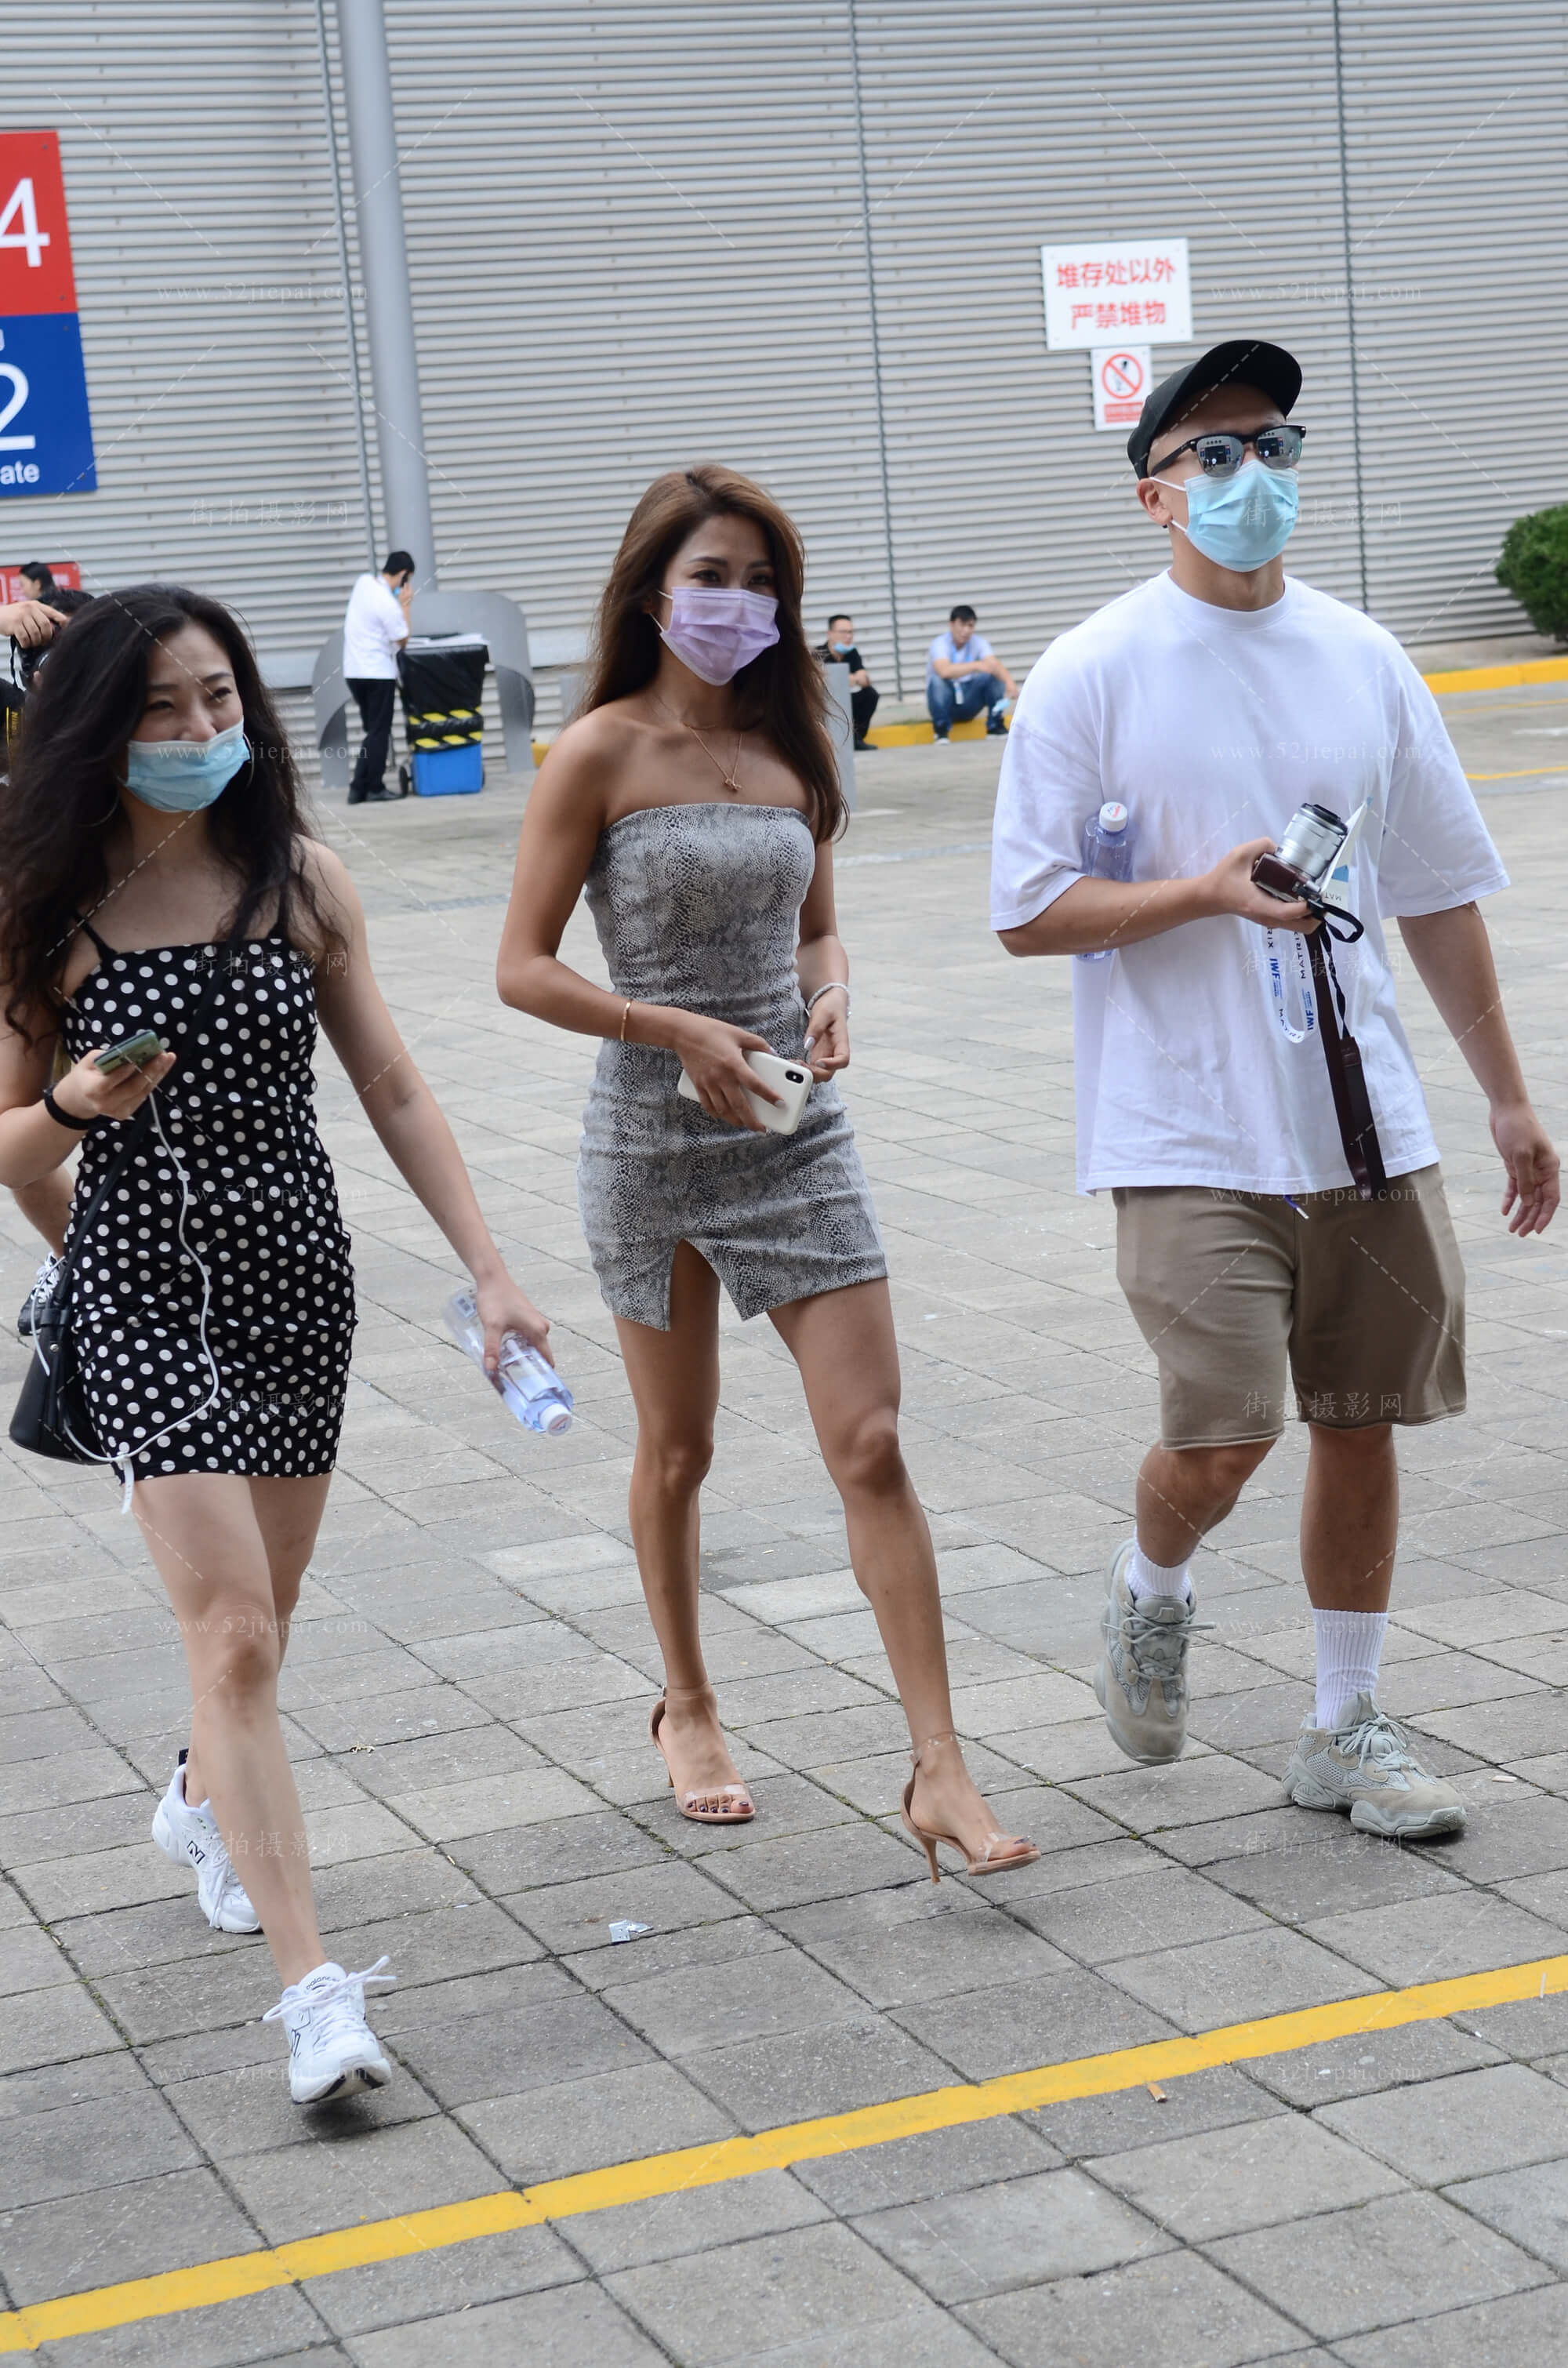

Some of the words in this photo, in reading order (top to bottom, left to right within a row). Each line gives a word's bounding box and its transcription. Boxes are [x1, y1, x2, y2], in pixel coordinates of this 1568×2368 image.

[1056, 256, 1176, 289] 堆存处以外
[1071, 300, 1167, 330] 严禁堆物
[0, 459, 40, 485] ate
[1269, 958, 1280, 979] IWF
[1305, 1010, 1314, 1030] IWF
